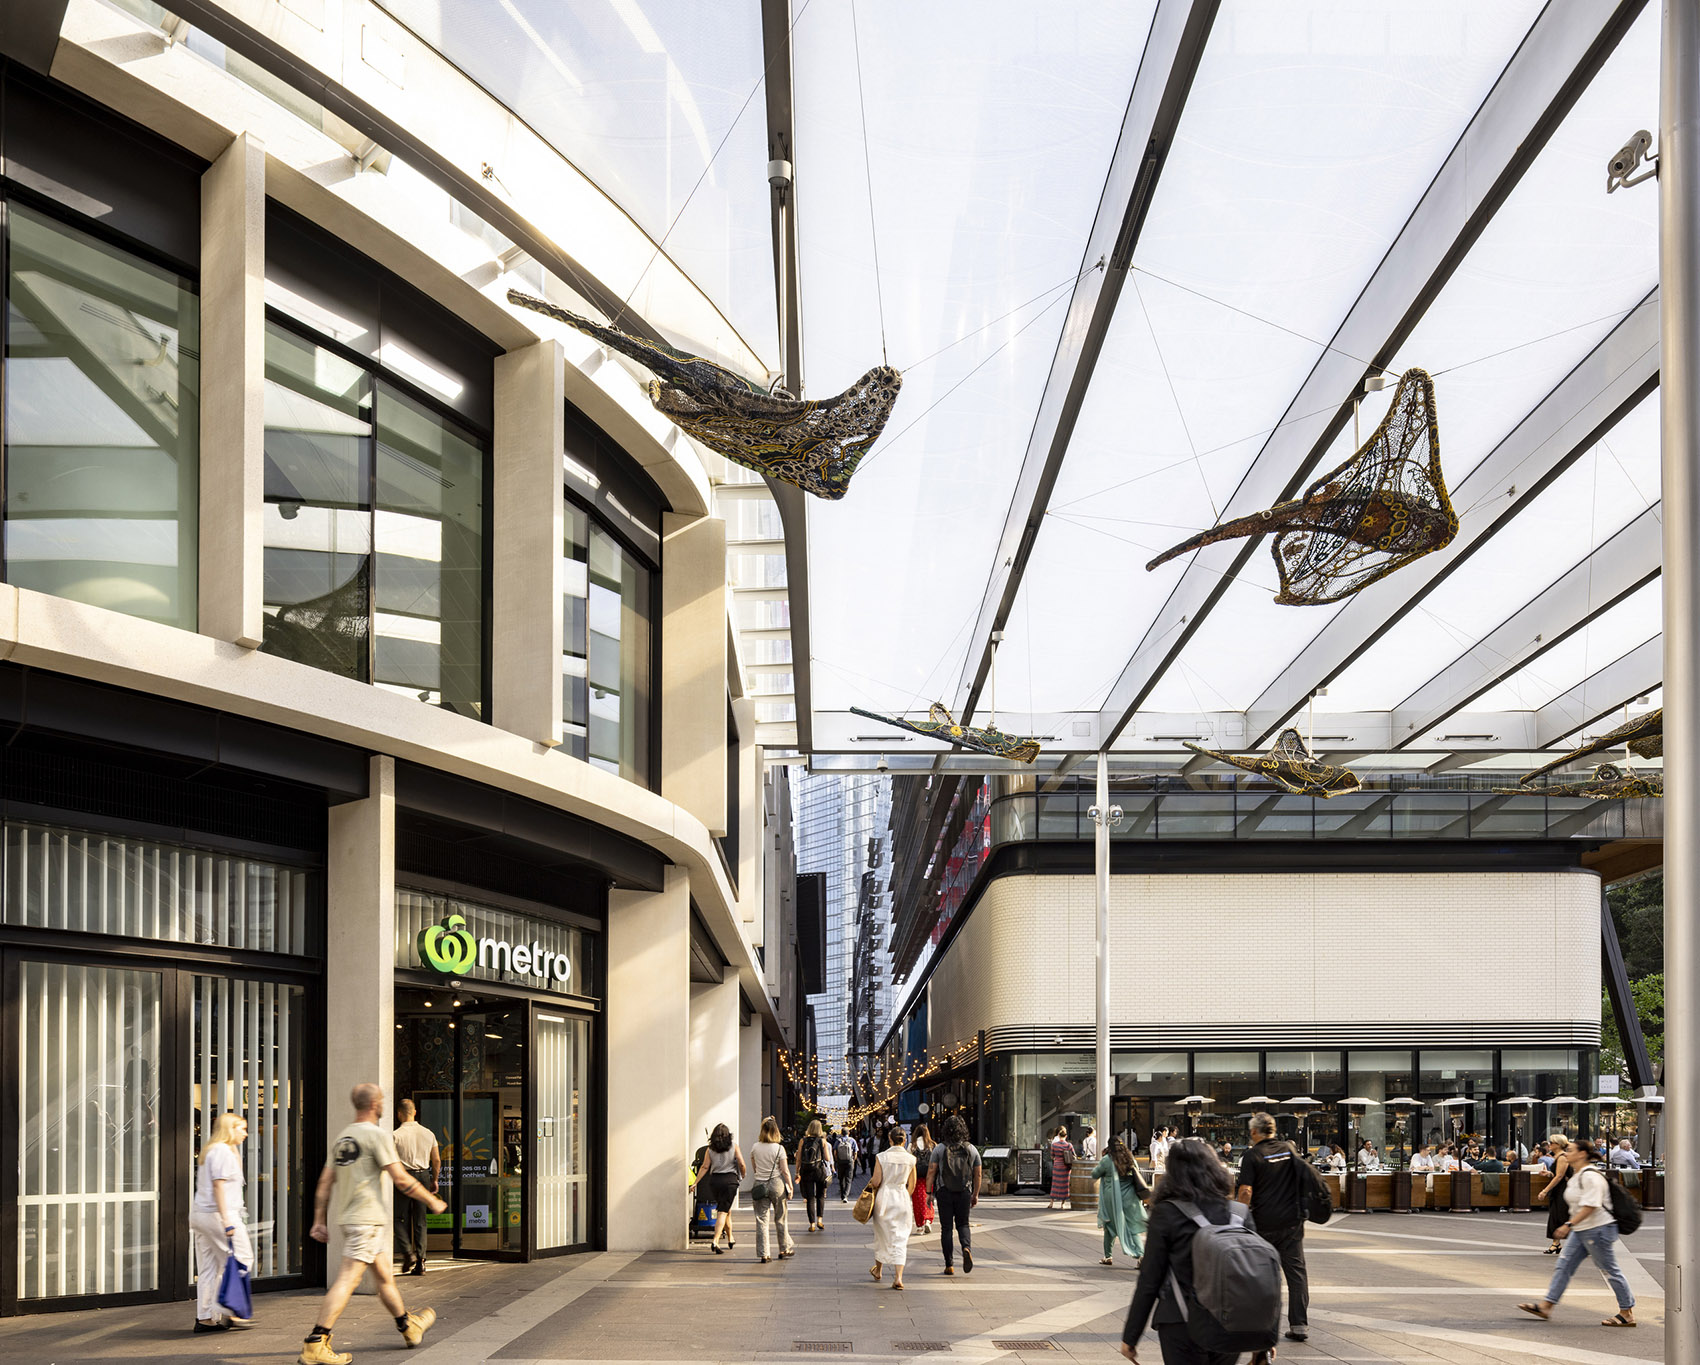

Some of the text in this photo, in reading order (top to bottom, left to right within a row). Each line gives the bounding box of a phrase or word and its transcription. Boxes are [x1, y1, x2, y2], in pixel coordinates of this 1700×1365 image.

[479, 937, 571, 982] metro
[1270, 1068, 1340, 1077] WILD SAGE
